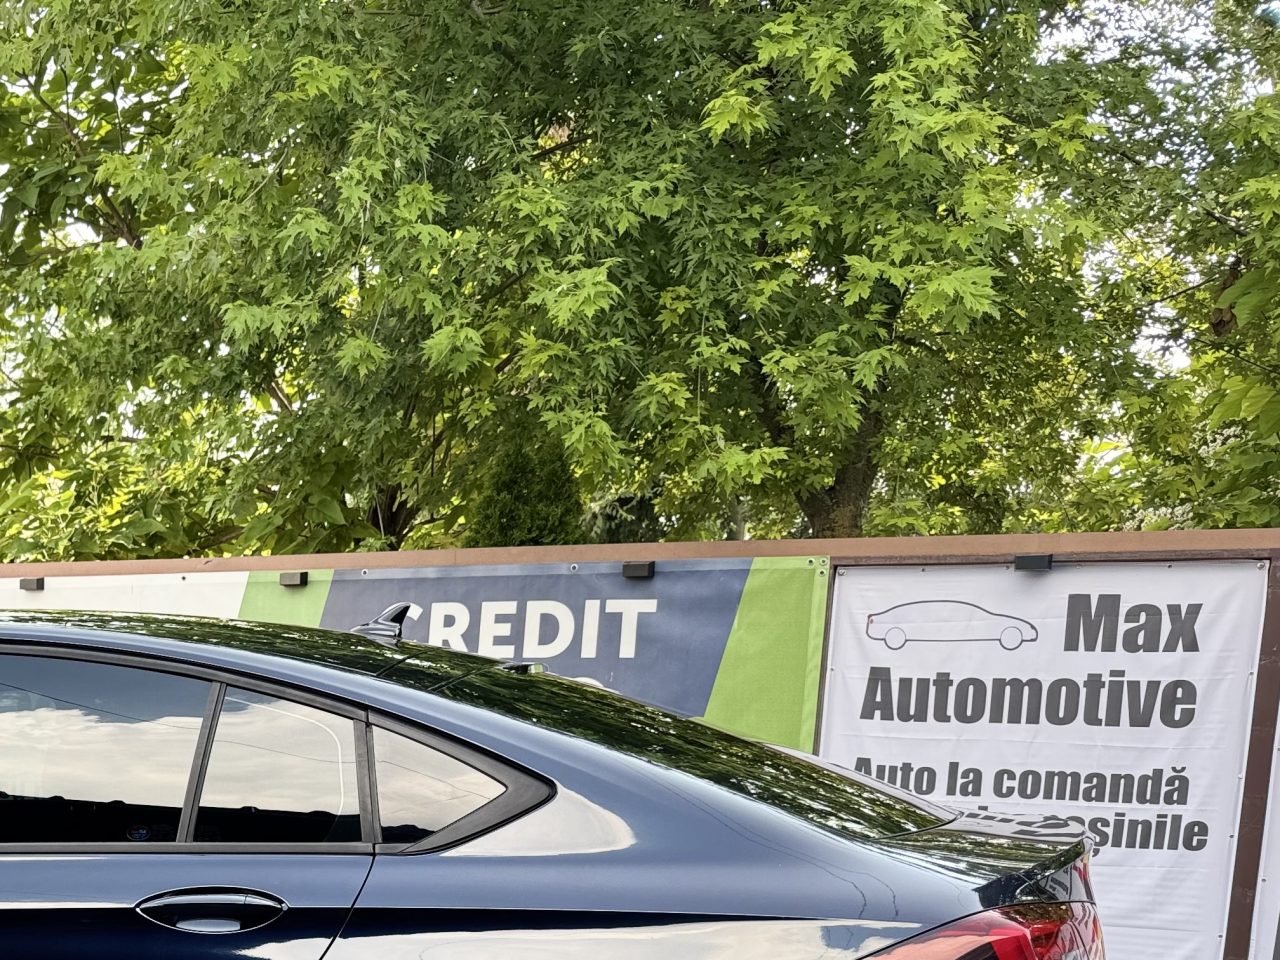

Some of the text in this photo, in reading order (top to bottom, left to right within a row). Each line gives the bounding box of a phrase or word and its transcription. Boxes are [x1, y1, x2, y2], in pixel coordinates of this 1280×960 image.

[1063, 593, 1204, 653] Max
[859, 666, 1199, 729] Automotive
[946, 761, 983, 797] la
[993, 766, 1190, 806] comandă
[1043, 812, 1209, 857] șinile
